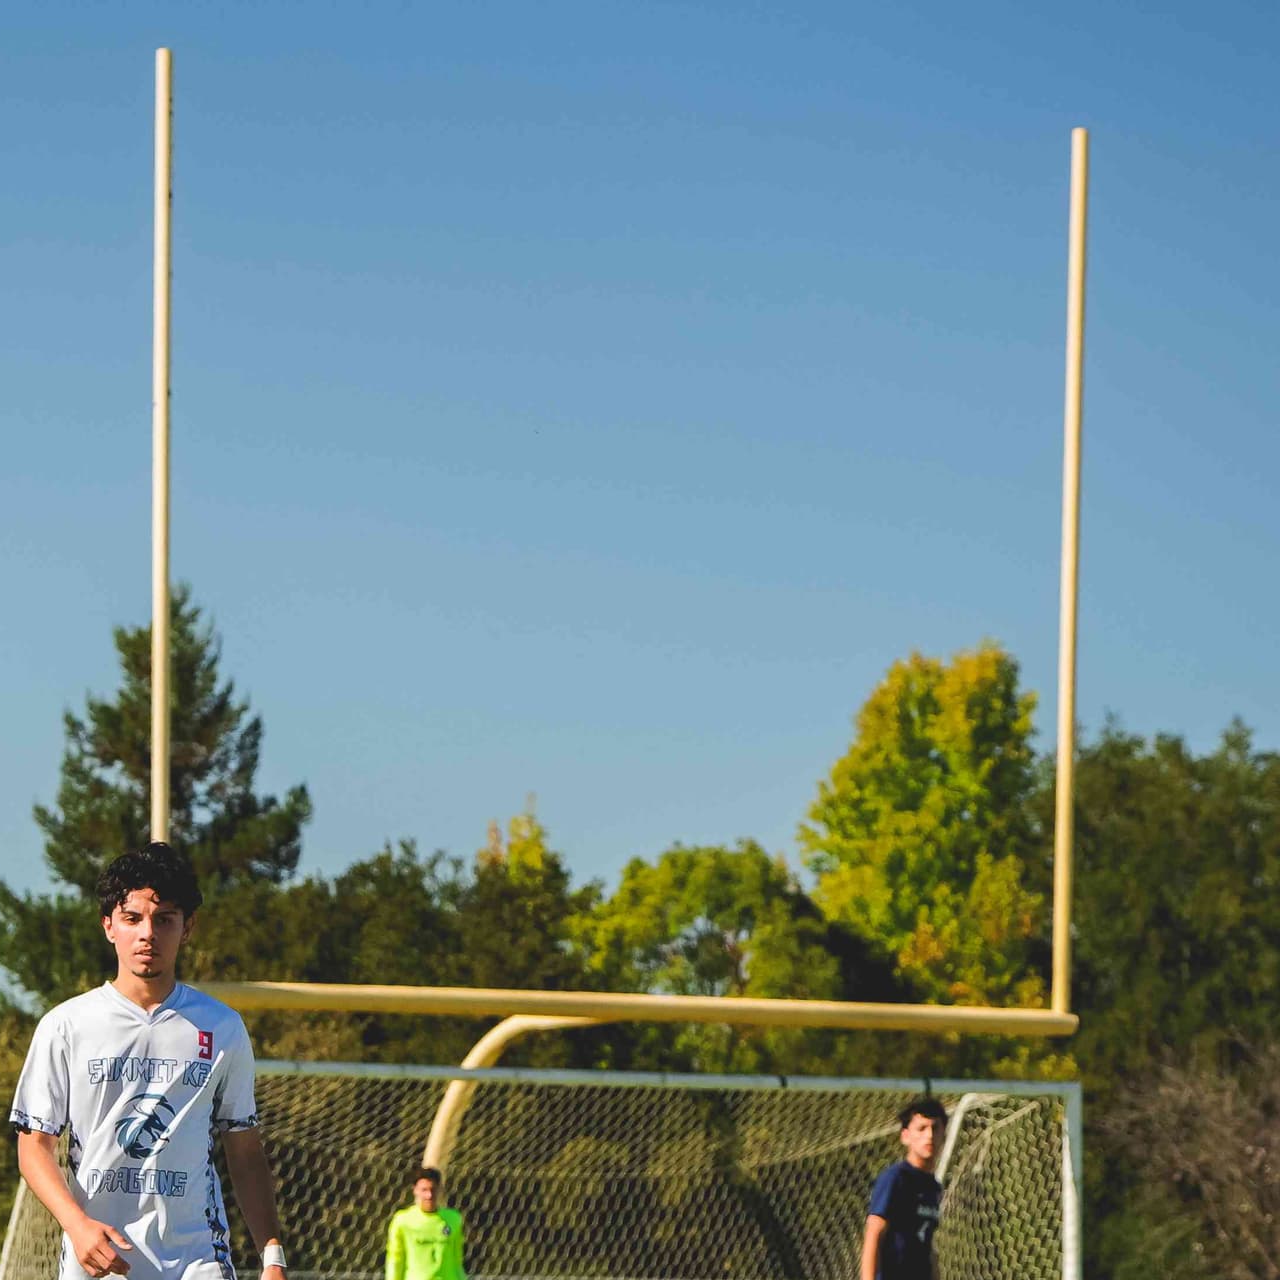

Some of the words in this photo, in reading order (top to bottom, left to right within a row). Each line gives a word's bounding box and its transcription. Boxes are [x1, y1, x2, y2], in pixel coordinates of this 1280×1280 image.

[198, 1030, 214, 1060] 9
[88, 1057, 178, 1084] SUMMIT
[87, 1167, 188, 1197] DRAGONS
